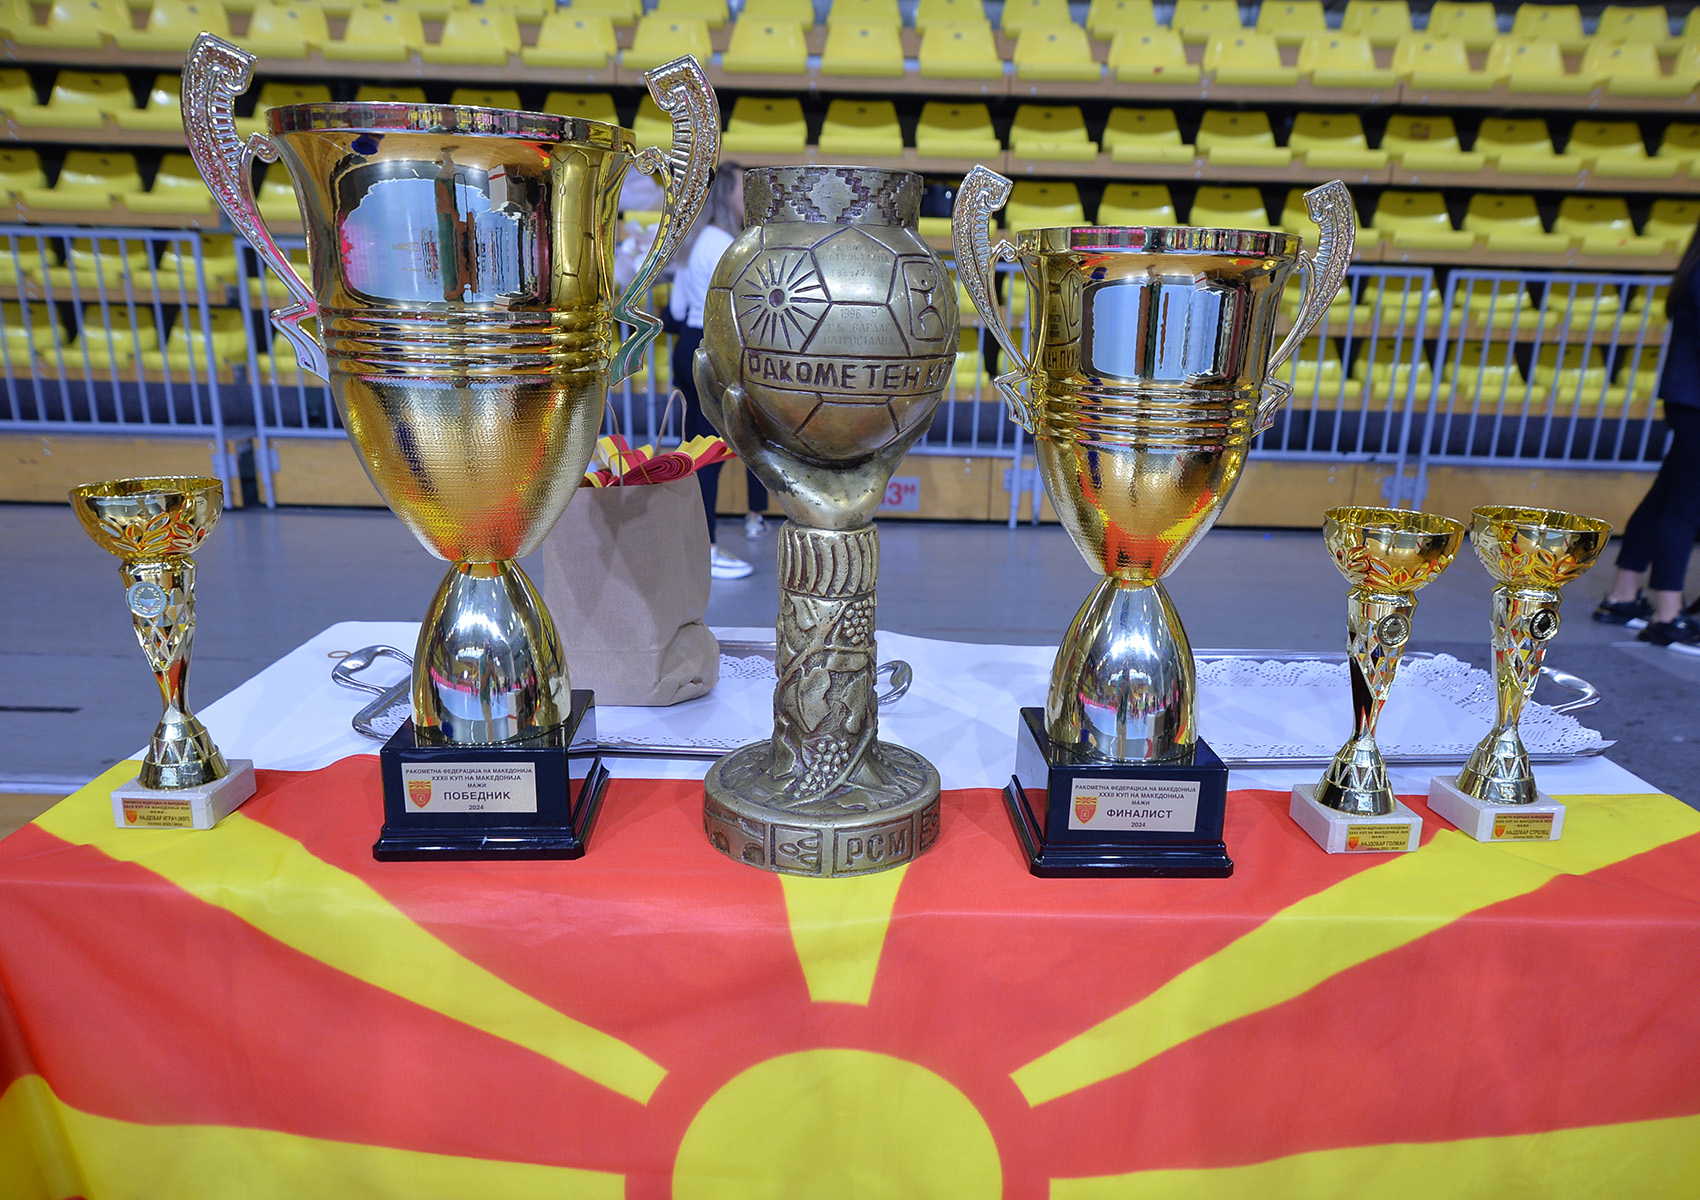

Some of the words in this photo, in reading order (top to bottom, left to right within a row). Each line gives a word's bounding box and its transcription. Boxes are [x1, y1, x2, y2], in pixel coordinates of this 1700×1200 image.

[747, 353, 922, 391] РАКОМЕТЕН
[443, 791, 511, 802] ПОБЕДНИК
[1106, 809, 1173, 819] ФИНАЛИСТ
[845, 828, 907, 867] РСМ
